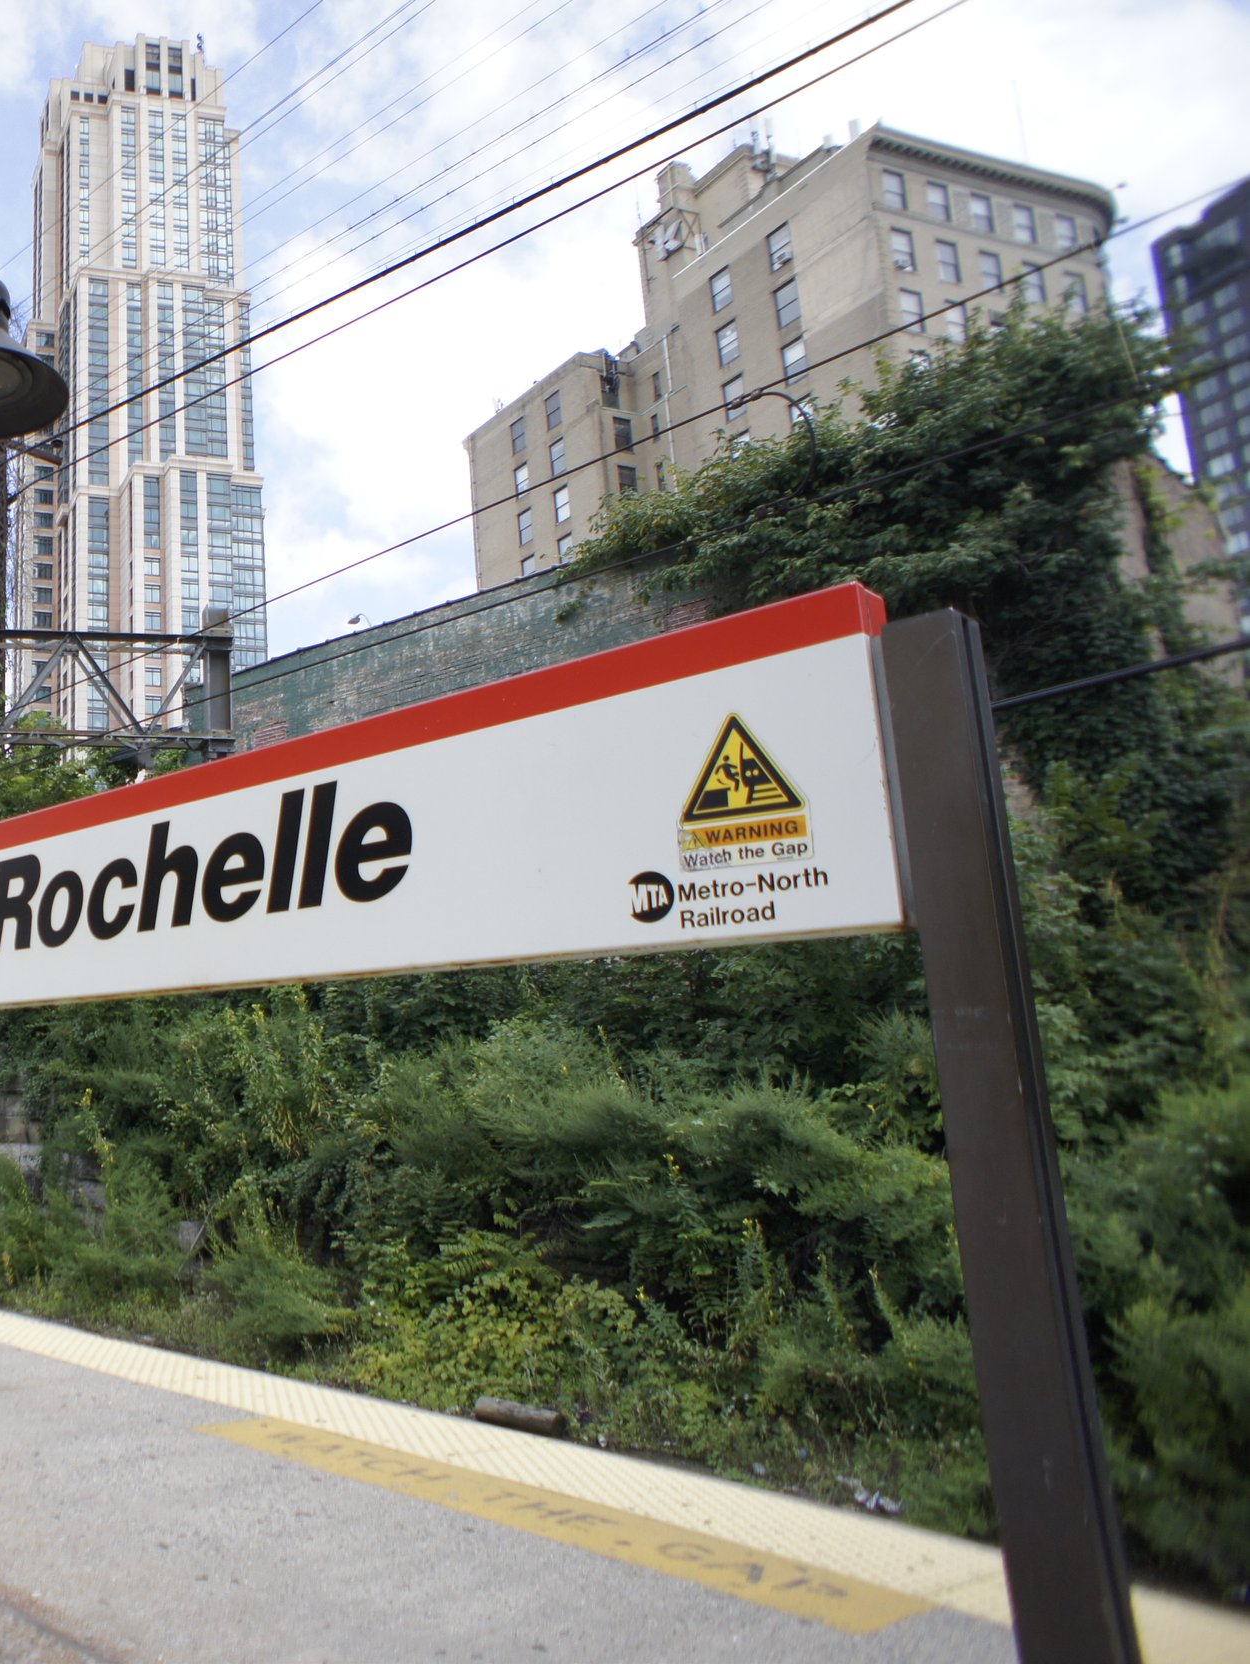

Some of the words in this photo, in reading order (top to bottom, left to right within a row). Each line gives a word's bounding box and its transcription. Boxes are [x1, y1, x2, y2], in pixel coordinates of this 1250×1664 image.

[704, 819, 799, 844] WARNING
[683, 848, 732, 868] Watch
[737, 845, 765, 860] the
[771, 841, 808, 857] Gap
[628, 882, 671, 916] MTA
[677, 867, 829, 902] Metro-North
[680, 901, 776, 928] Railroad
[267, 1432, 451, 1481] WATCH
[482, 1491, 619, 1526] THE
[657, 1541, 849, 1598] GAP
